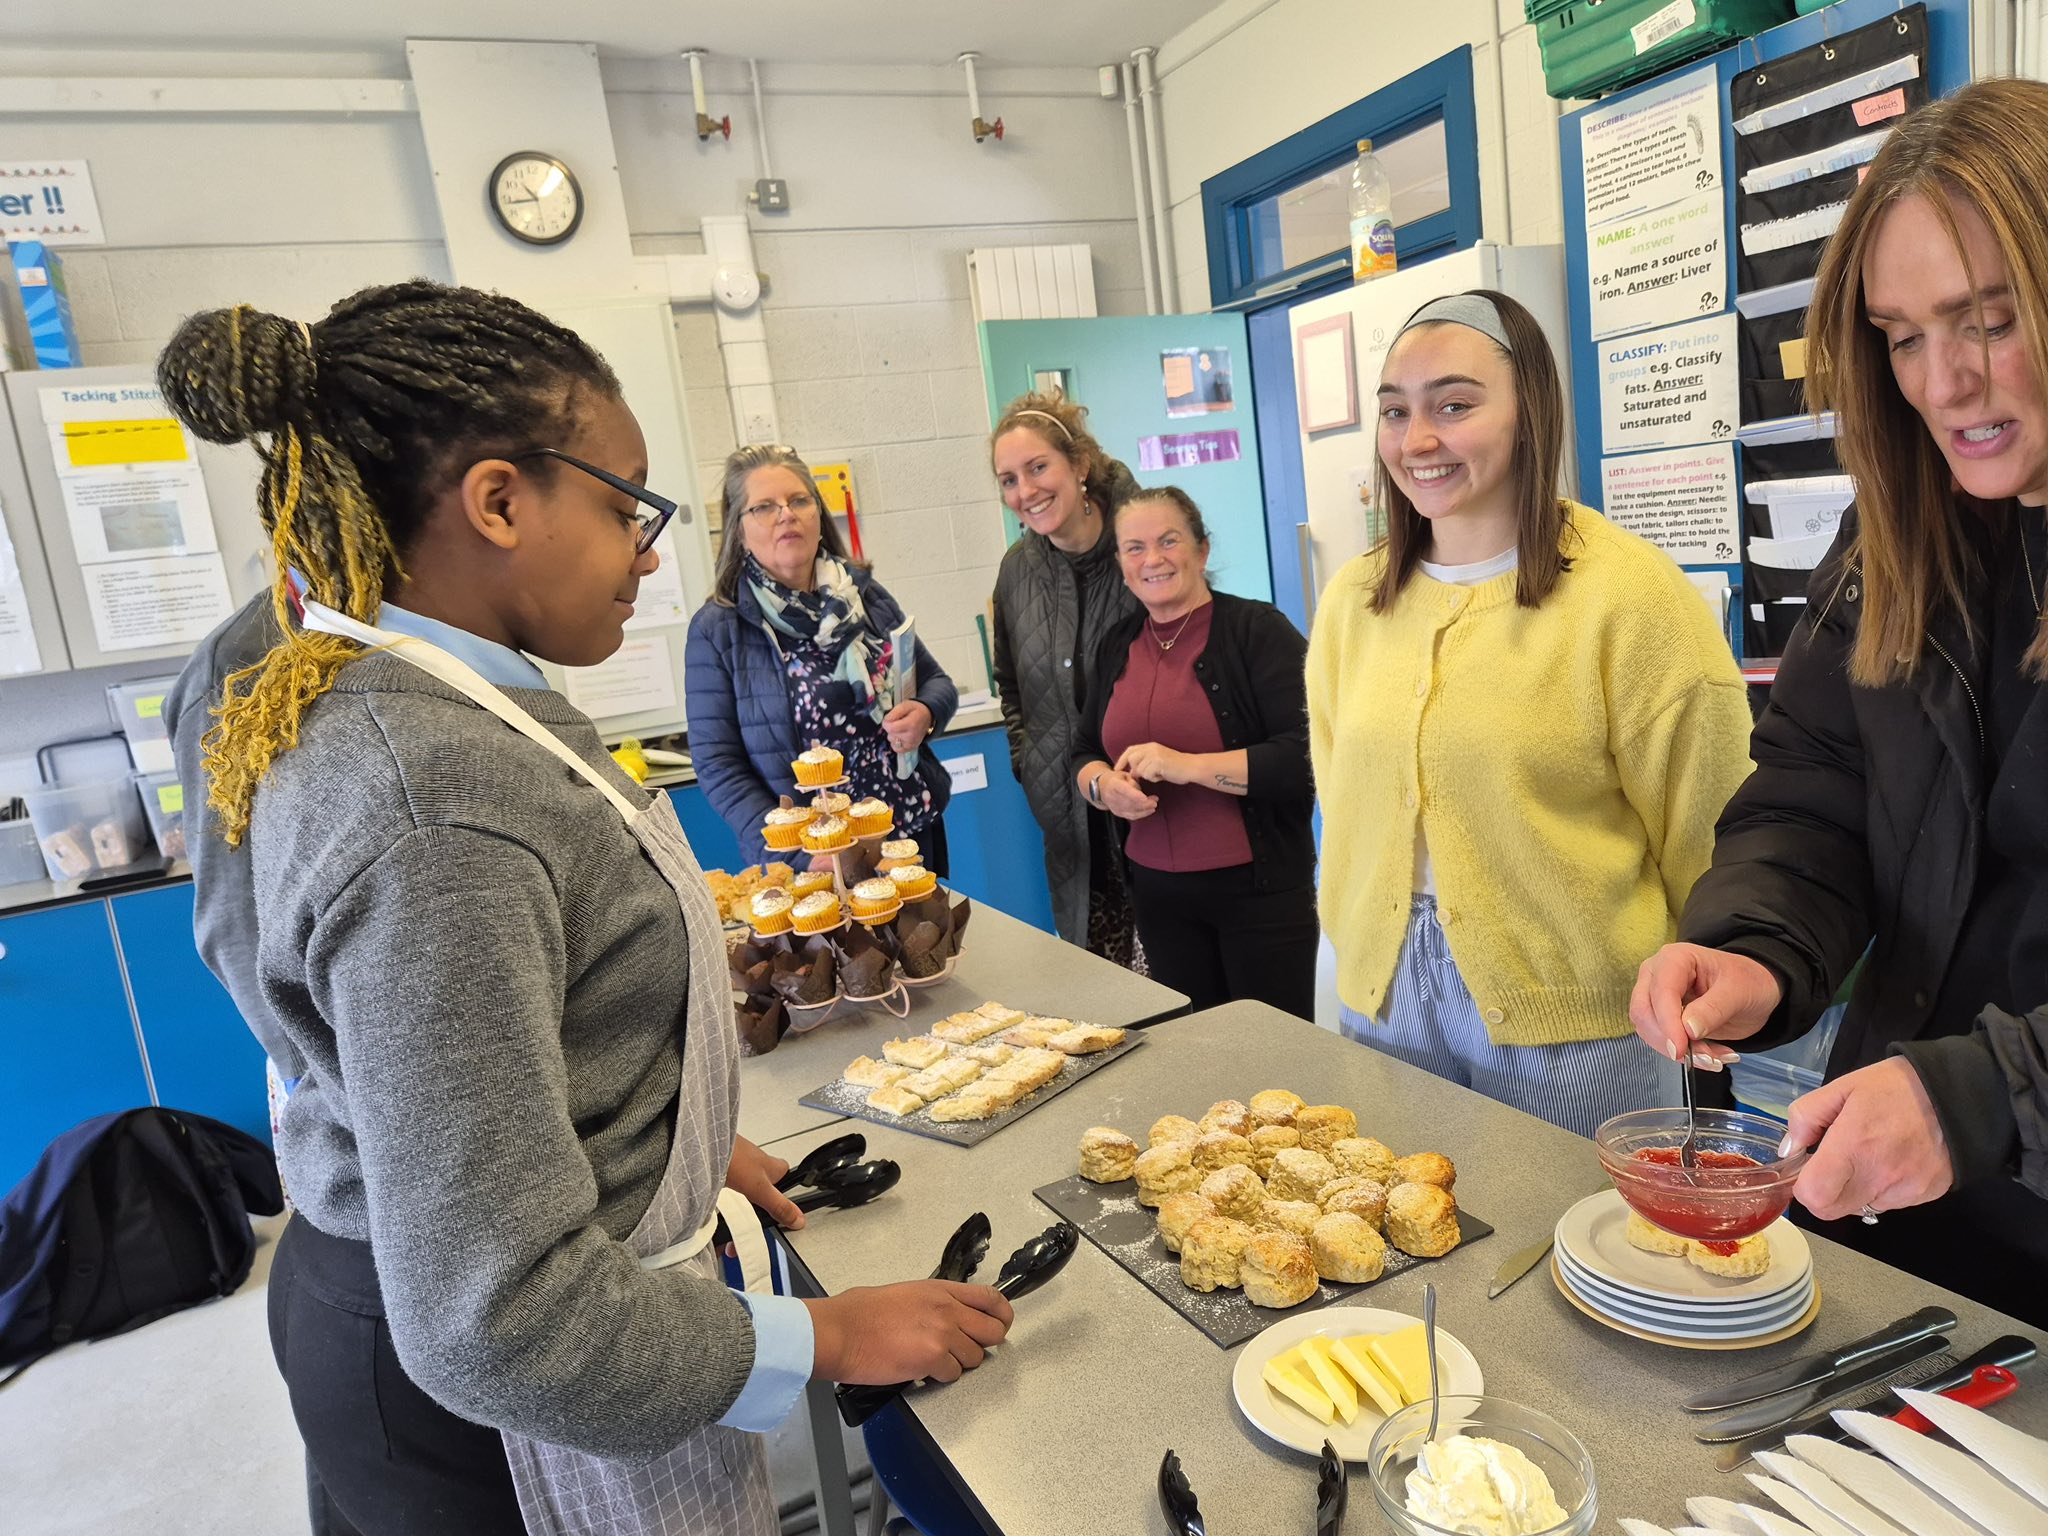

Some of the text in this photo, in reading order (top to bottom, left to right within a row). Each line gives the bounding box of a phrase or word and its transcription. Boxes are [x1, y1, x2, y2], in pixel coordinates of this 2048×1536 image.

[1863, 100, 1899, 116] Contracts
[1587, 113, 1627, 134] DESCRIBE:
[1596, 146, 1620, 159] Describe
[1622, 141, 1632, 149] the
[1634, 136, 1650, 146] types
[1659, 125, 1677, 136] teeth.
[1610, 154, 1627, 165] There
[1628, 150, 1637, 158] are
[1644, 140, 1661, 155] types
[1662, 136, 1669, 144] of
[1670, 132, 1686, 142] teeth
[527, 165, 538, 174] 12
[1592, 172, 1602, 180] the
[1630, 156, 1654, 168] incisors
[1662, 148, 1672, 157] cut
[1674, 142, 1686, 153] and
[515, 169, 524, 178] 11
[1587, 189, 1615, 203] premolars
[1616, 184, 1627, 193] and
[1629, 180, 1636, 188] 12
[1660, 166, 1675, 176] both
[1685, 157, 1702, 168] chew
[1620, 170, 1643, 182] canines
[1651, 162, 1664, 172] tear
[506, 180, 518, 189] 10
[1588, 204, 1599, 212] and
[1600, 198, 1615, 210] grind
[1597, 227, 1635, 248] NAME:
[1639, 222, 1648, 234] A
[1652, 216, 1676, 230] one
[1678, 202, 1708, 222] word
[1630, 234, 1675, 255] answer
[1593, 239, 1718, 286] e.g. Name a source of
[1599, 262, 1712, 302] iron. Answer: Liver
[1610, 334, 1719, 363] CLASSIFY: Put into
[1608, 351, 1722, 384] groups e.g. Classify
[1625, 374, 1703, 395] fats. Answer:
[62, 391, 117, 404] Tacking
[1623, 390, 1707, 412] Saturated and
[1620, 411, 1691, 430] unsaturated
[1608, 457, 1725, 477] LIST: Answer in points. Give
[1614, 480, 1650, 490] sentence
[1667, 475, 1687, 484] each
[1689, 473, 1713, 484] point
[1637, 489, 1676, 500] equipment
[1678, 486, 1714, 496] necessary
[1635, 500, 1665, 508] cushion.
[1687, 507, 1718, 515] scissors:
[1641, 521, 1664, 530] fabric,
[1669, 531, 1687, 539] pins:
[1678, 540, 1707, 548] tacking
